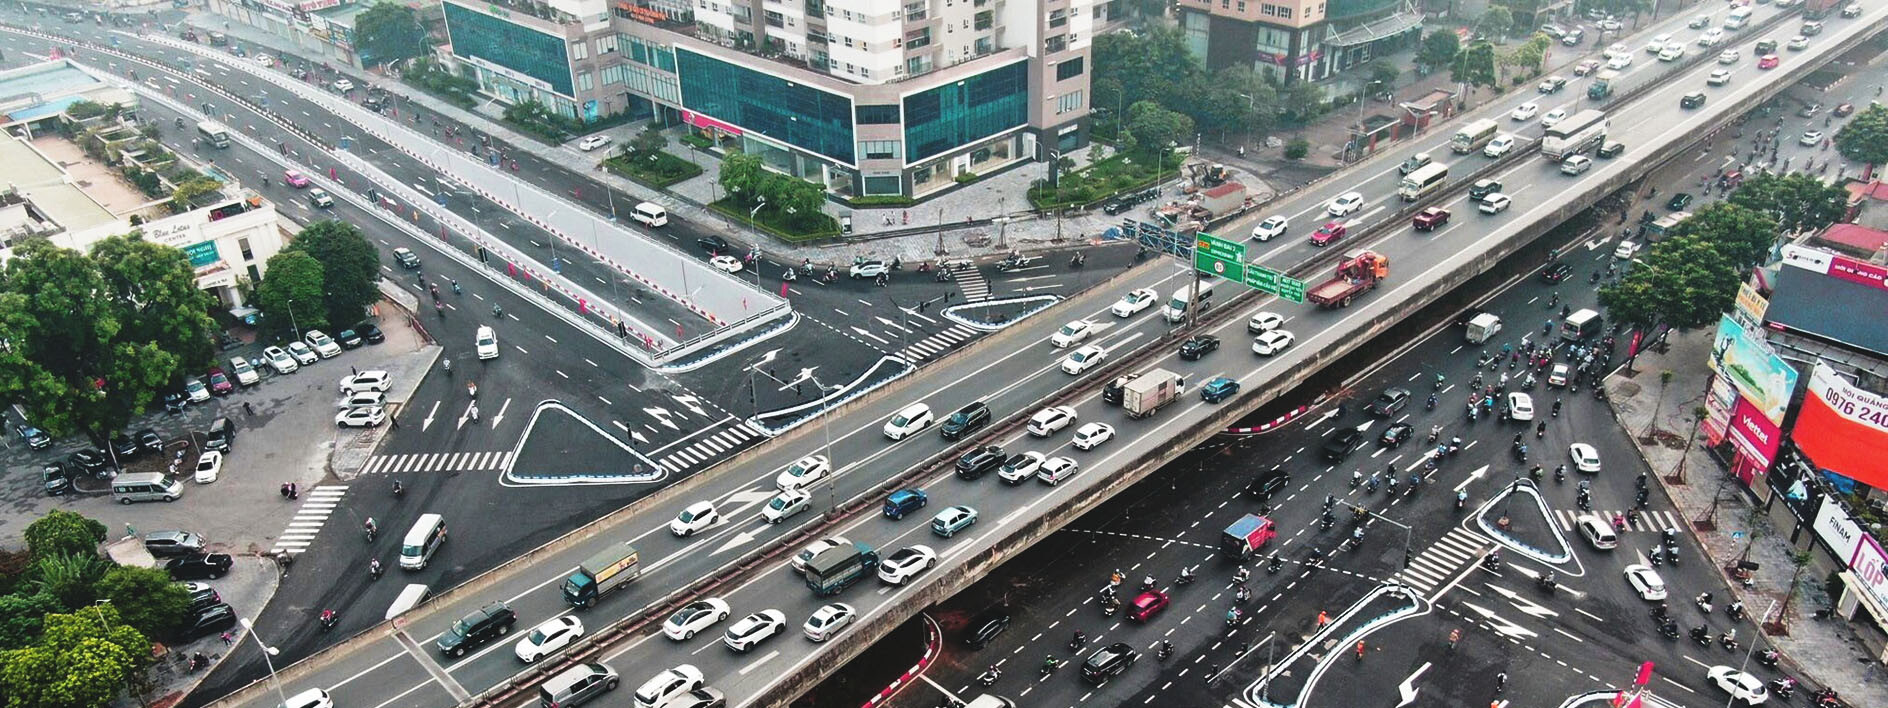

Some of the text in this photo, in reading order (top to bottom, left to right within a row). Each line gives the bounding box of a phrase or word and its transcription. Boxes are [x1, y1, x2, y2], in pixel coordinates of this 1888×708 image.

[1826, 387, 1856, 415] 0976
[1829, 516, 1851, 543] FINAM
[1857, 552, 1884, 588] LỐP
